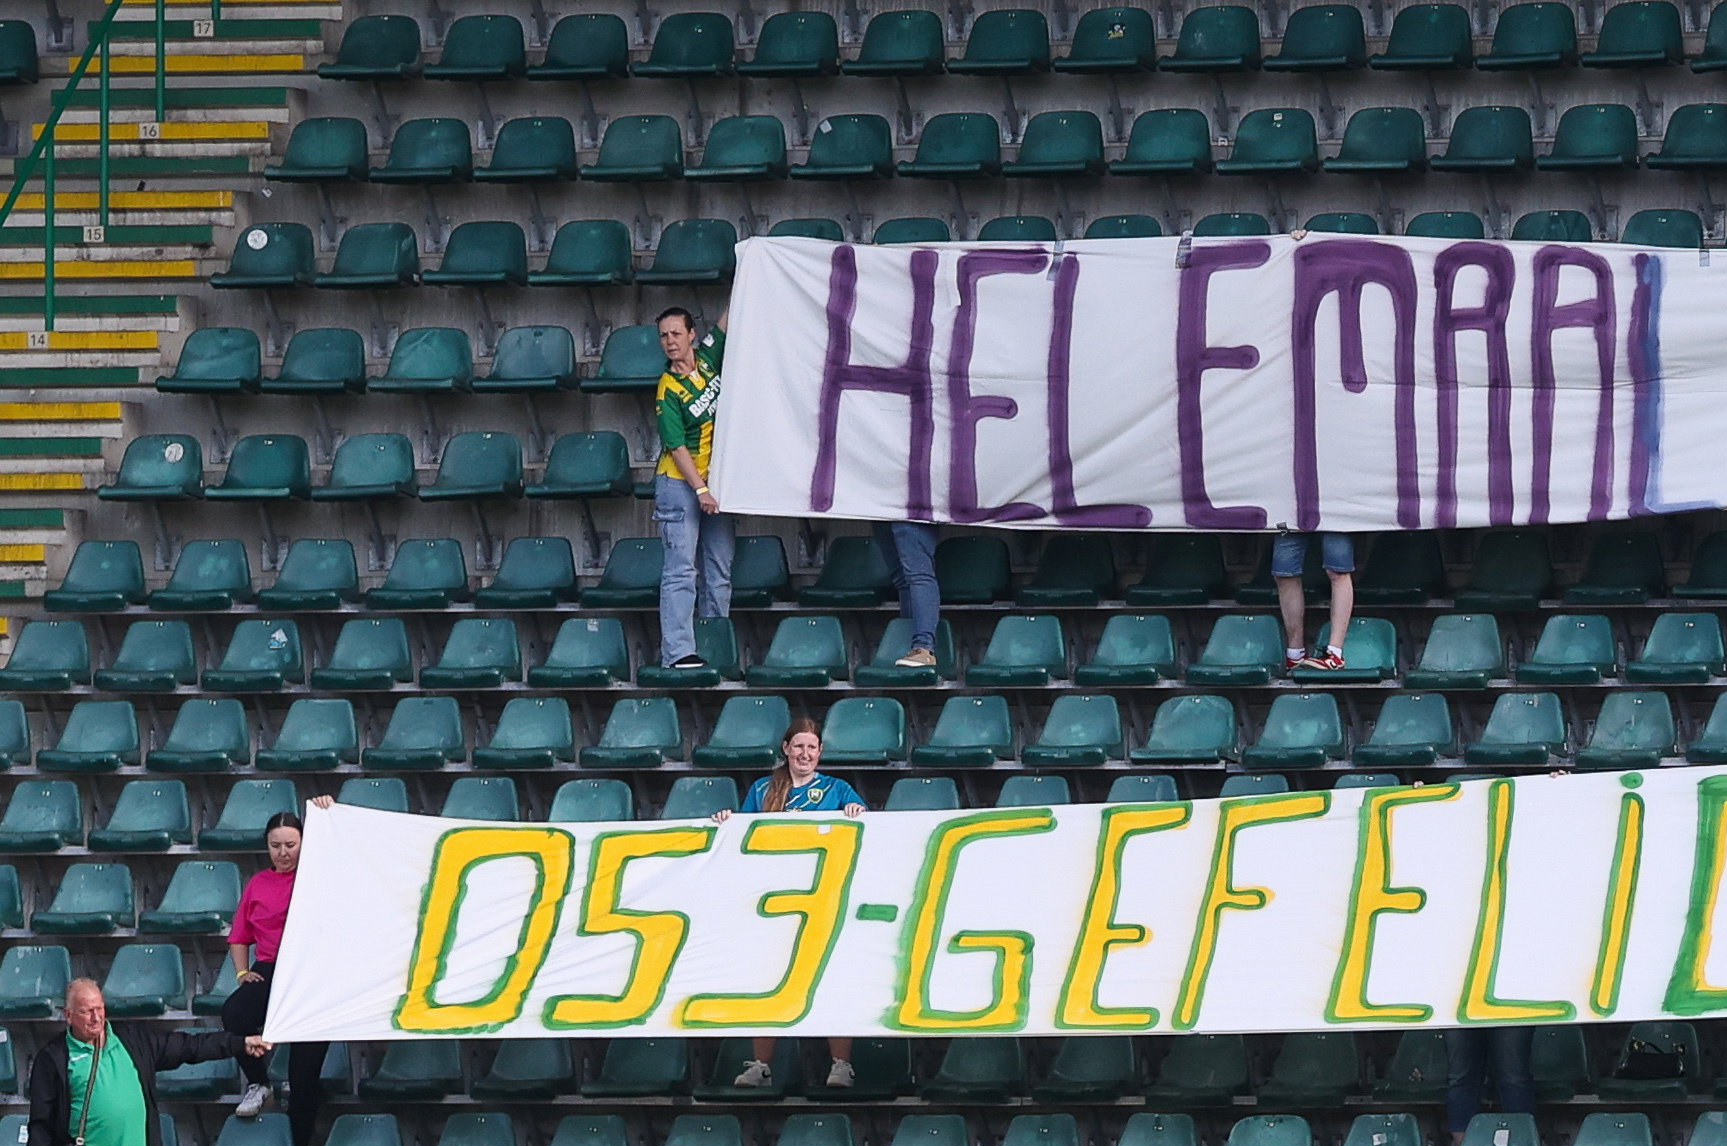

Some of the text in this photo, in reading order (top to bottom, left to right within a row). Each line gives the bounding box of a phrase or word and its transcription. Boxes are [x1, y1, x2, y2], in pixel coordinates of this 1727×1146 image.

[196, 22, 213, 36] 17
[141, 124, 158, 139] 16
[86, 227, 102, 243] 15
[29, 332, 47, 348] 14
[810, 238, 1668, 532] HELEMAAL
